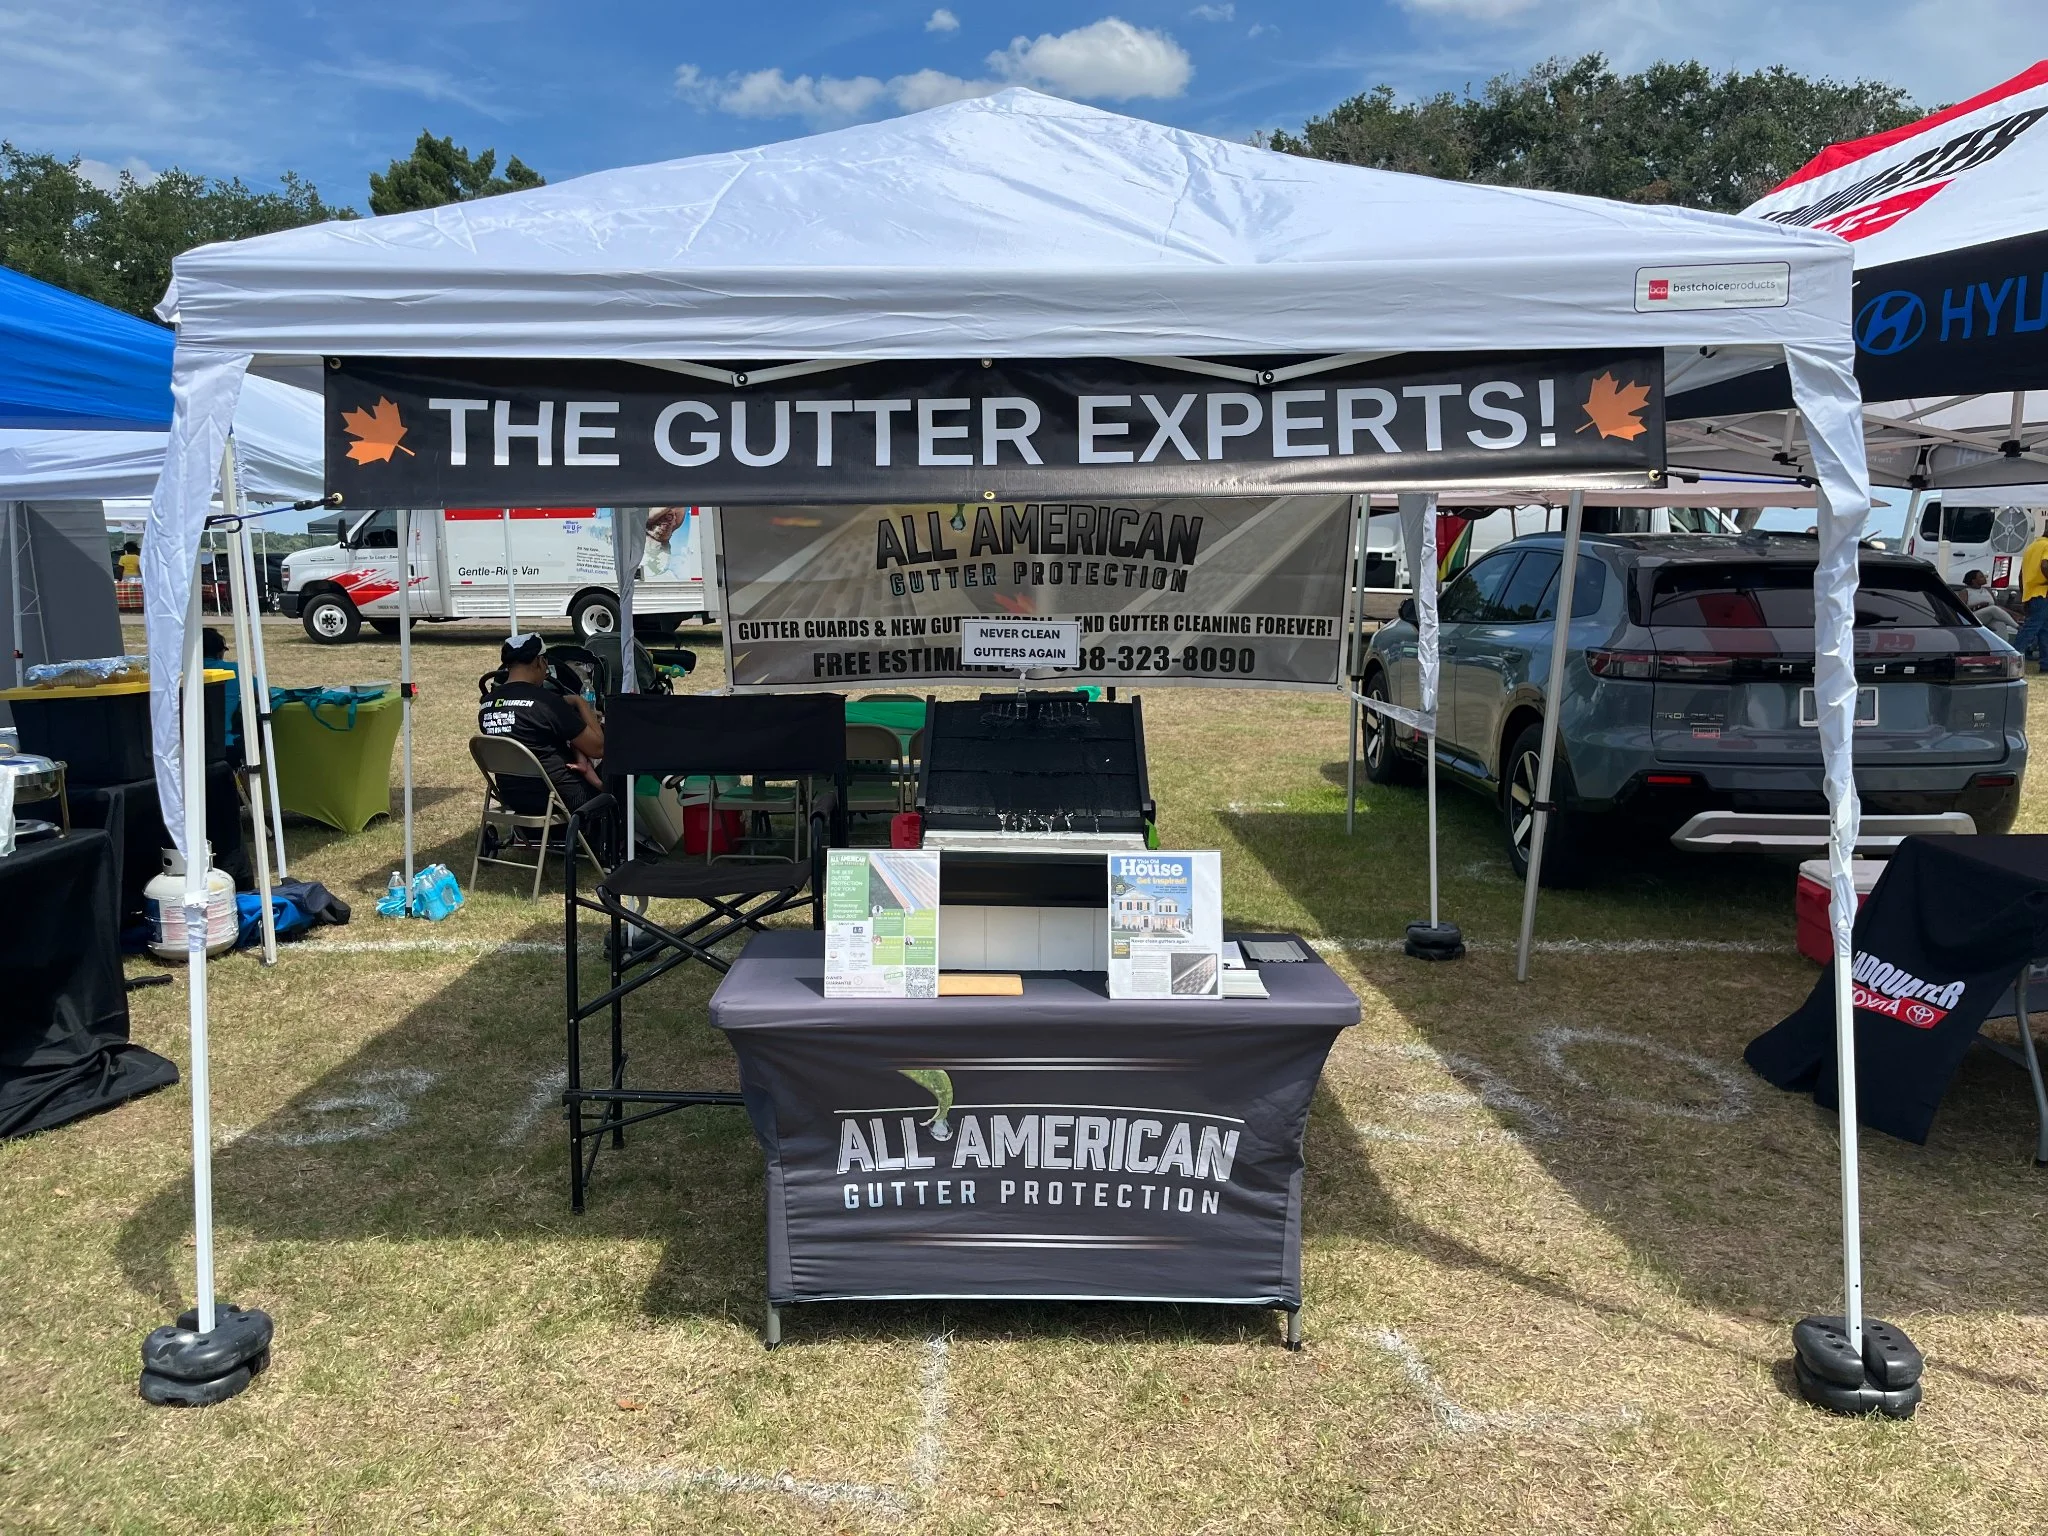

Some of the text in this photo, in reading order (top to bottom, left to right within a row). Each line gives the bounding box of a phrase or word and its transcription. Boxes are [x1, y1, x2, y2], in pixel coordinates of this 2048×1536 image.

[1673, 280, 1775, 293] bestchoiceproducts
[428, 379, 1557, 467] THE GUTTER EXPERTS!
[876, 504, 1203, 569] ALL AMERICAN
[521, 566, 540, 576] Van
[890, 561, 1188, 596] GUTTER PROTECTION
[738, 621, 799, 641] GUTTER
[804, 619, 869, 639] GUARDS
[874, 620, 887, 638] &
[891, 618, 926, 636] NEW
[1109, 615, 1169, 633] GUTTER
[1173, 615, 1251, 634] CLEANING
[1256, 616, 1333, 637] FOREVER!
[980, 629, 1060, 639] NEVER CLEAN
[813, 651, 872, 678] FREE
[973, 647, 1066, 659] GUTTERS AGAIN
[1120, 859, 1184, 877] House
[837, 1115, 1240, 1182] ALL AMERICAN
[843, 1180, 1220, 1215] GUTTER PROTECTION
